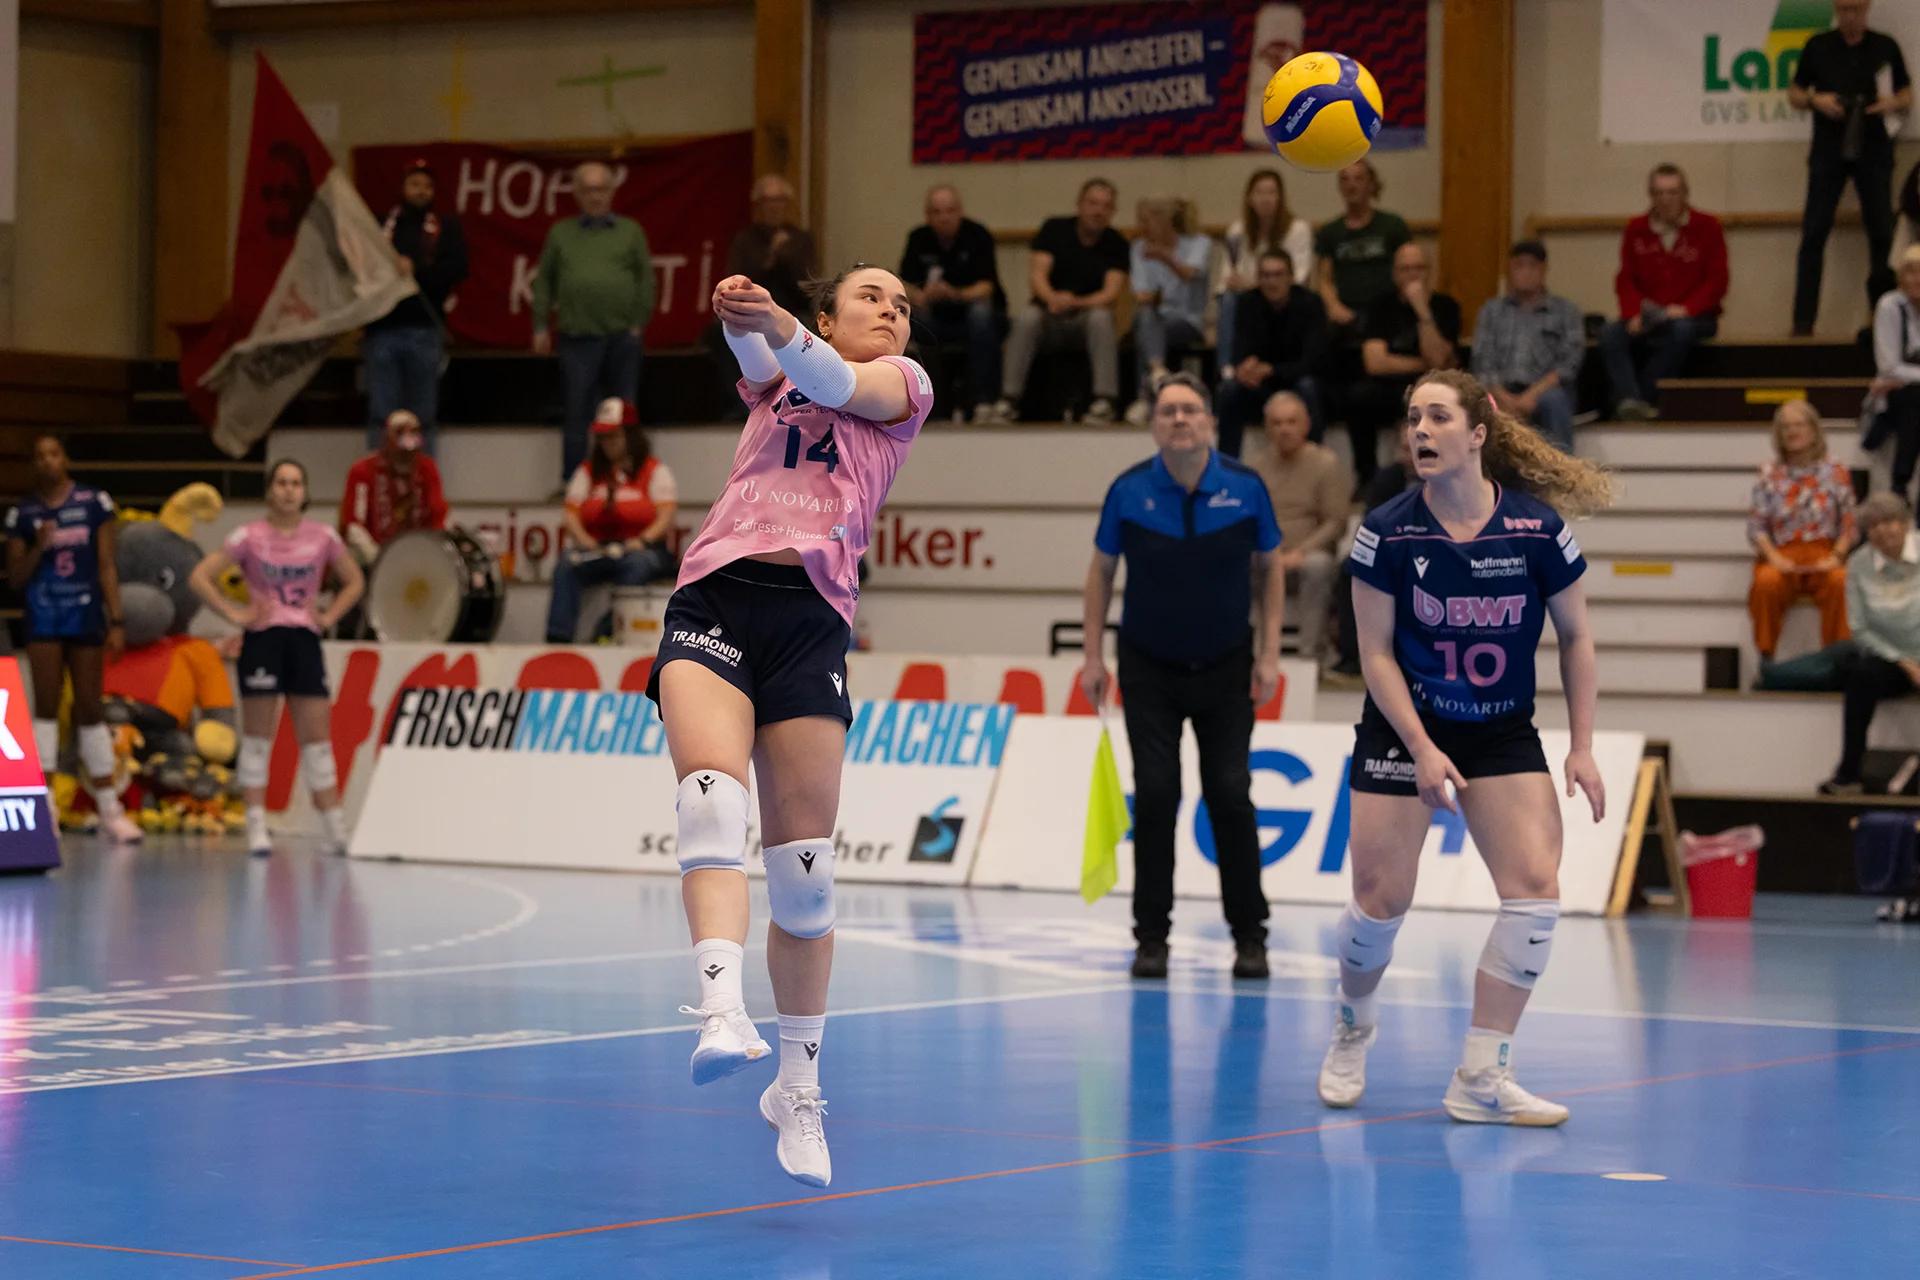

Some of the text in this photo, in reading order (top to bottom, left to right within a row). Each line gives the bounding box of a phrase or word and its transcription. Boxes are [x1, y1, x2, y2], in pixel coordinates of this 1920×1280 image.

[962, 47, 1084, 97] GEMEINSAM
[1086, 30, 1204, 78] ANGREIFEN
[1704, 34, 1806, 93] Lan
[963, 91, 1085, 138] GEMEINSAM
[1088, 73, 1213, 122] ANSTOSSEN.
[776, 417, 840, 474] 14
[768, 490, 854, 513] NOVARTS
[1470, 556, 1523, 570] hoffmann
[1471, 566, 1525, 579] automobile
[1445, 594, 1527, 627] BWT
[671, 630, 743, 663] TRAMONDI
[1433, 640, 1508, 688] 10
[1433, 694, 1516, 716] NOVARTIS
[1364, 757, 1415, 777] TRAMOND
